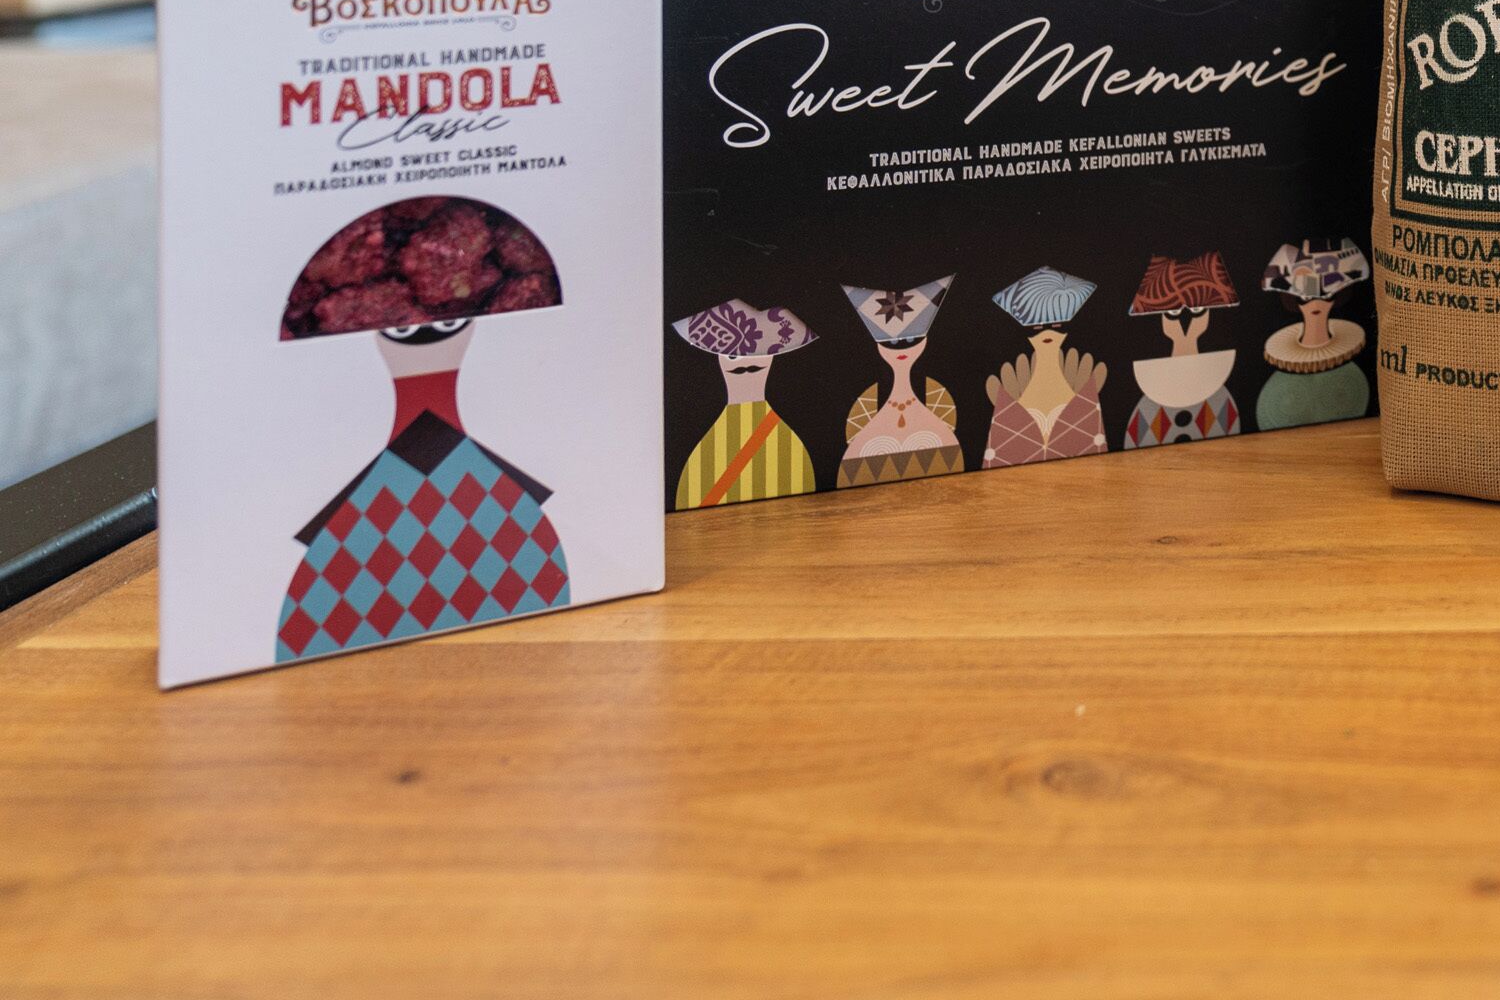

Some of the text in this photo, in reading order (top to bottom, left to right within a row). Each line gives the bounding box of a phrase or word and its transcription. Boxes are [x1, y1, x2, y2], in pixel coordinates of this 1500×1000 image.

[300, 43, 547, 76] TRADITIONAL HANDMADE
[279, 63, 562, 128] MANDOLA
[708, 16, 1348, 148] Sweet Memories
[336, 103, 511, 151] Classic
[331, 145, 518, 173] ALMOND SWEET CLASSIC
[869, 126, 1231, 168] TRADITIONAL HANDMADE KEFALLONIAN SWEETS
[1406, 174, 1483, 200] APPELLATION
[1380, 344, 1408, 376] ml
